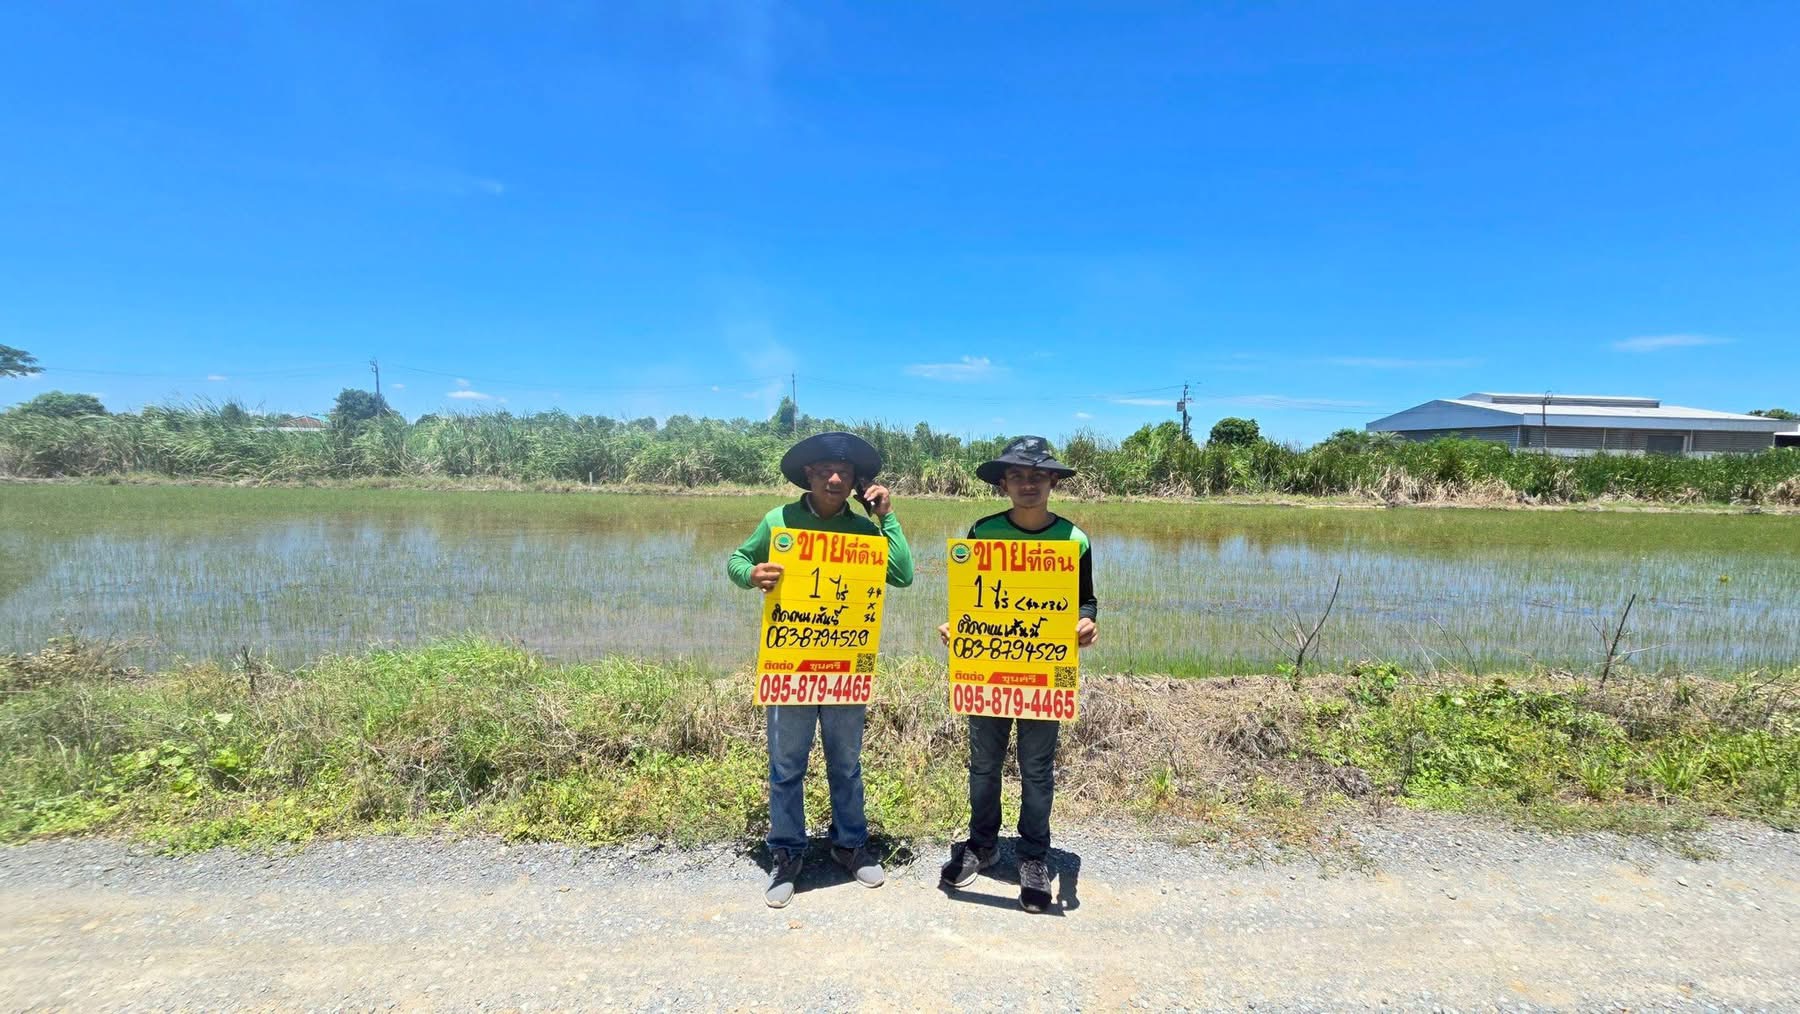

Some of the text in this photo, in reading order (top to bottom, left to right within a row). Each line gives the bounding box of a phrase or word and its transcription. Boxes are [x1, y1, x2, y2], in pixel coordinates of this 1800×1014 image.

[797, 531, 884, 565] ขายที่ดิน
[974, 541, 1075, 572] ขายที่ดิน
[808, 567, 849, 601] 1 ไร่
[973, 575, 984, 608] 1
[990, 579, 1009, 610] ไร่
[764, 659, 795, 671] ติดต่อ
[953, 637, 1068, 662] 083-8794529
[759, 674, 872, 703] 095-879-4465
[954, 670, 985, 682] ติดต่อ
[953, 684, 1076, 719] 095-879-4465
